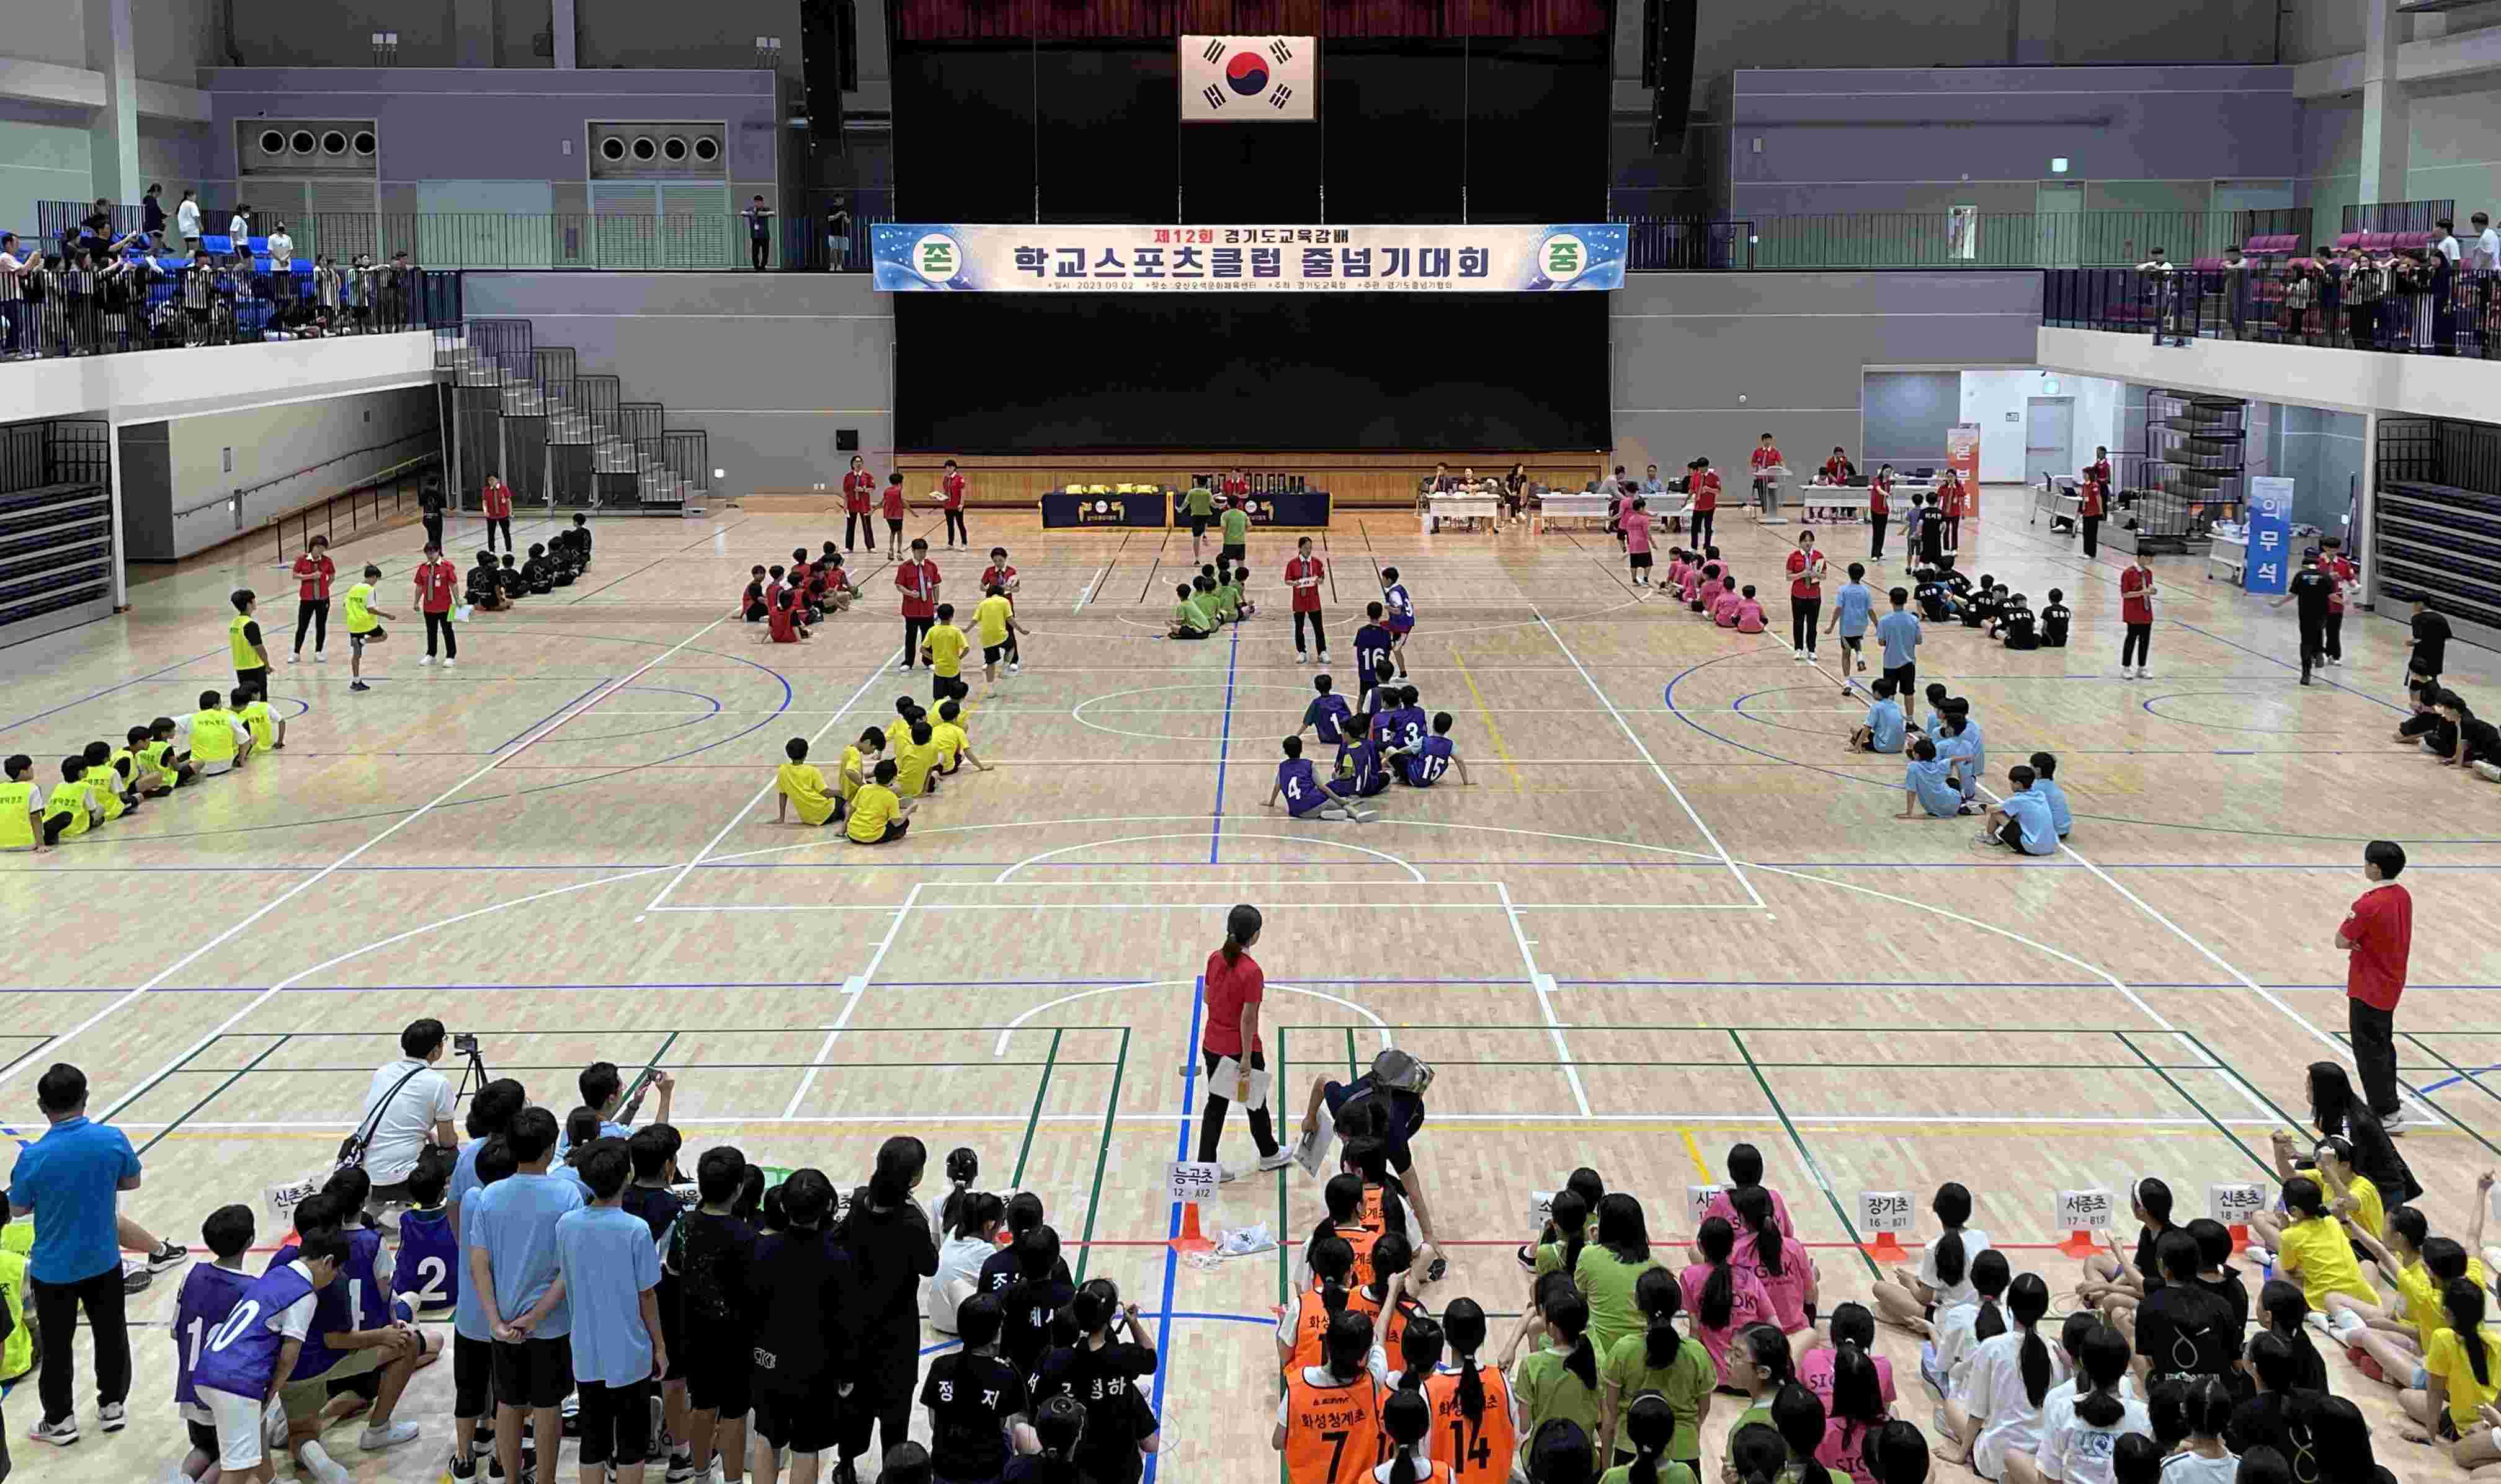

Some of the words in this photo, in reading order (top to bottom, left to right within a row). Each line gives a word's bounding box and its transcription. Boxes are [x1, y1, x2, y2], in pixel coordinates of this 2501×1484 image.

[1154, 229, 1213, 243] 제12회
[1225, 229, 1349, 243] 경기도교육감배
[923, 243, 952, 271] 존
[1014, 246, 1280, 277] 학교스포츠클럽
[1301, 246, 1489, 277] 줄넘기대회
[1549, 243, 1578, 271] 중
[2257, 498, 2280, 584] 의무석
[1422, 754, 1445, 781] 15
[1287, 776, 1301, 801] 4
[1172, 1166, 1213, 1186] 능곡초
[1174, 1188, 1184, 1197] 12
[2219, 1190, 2260, 1207] 신촌초
[1868, 1197, 1909, 1215] 장기초
[2066, 1195, 2107, 1213] 서종초
[1869, 1218, 1880, 1227] 16
[2067, 1216, 2078, 1225] 17
[2219, 1210, 2232, 1220] 18
[417, 1256, 447, 1302] 2
[1300, 1408, 1366, 1429] 화성청계초
[1322, 1430, 1349, 1484] 7
